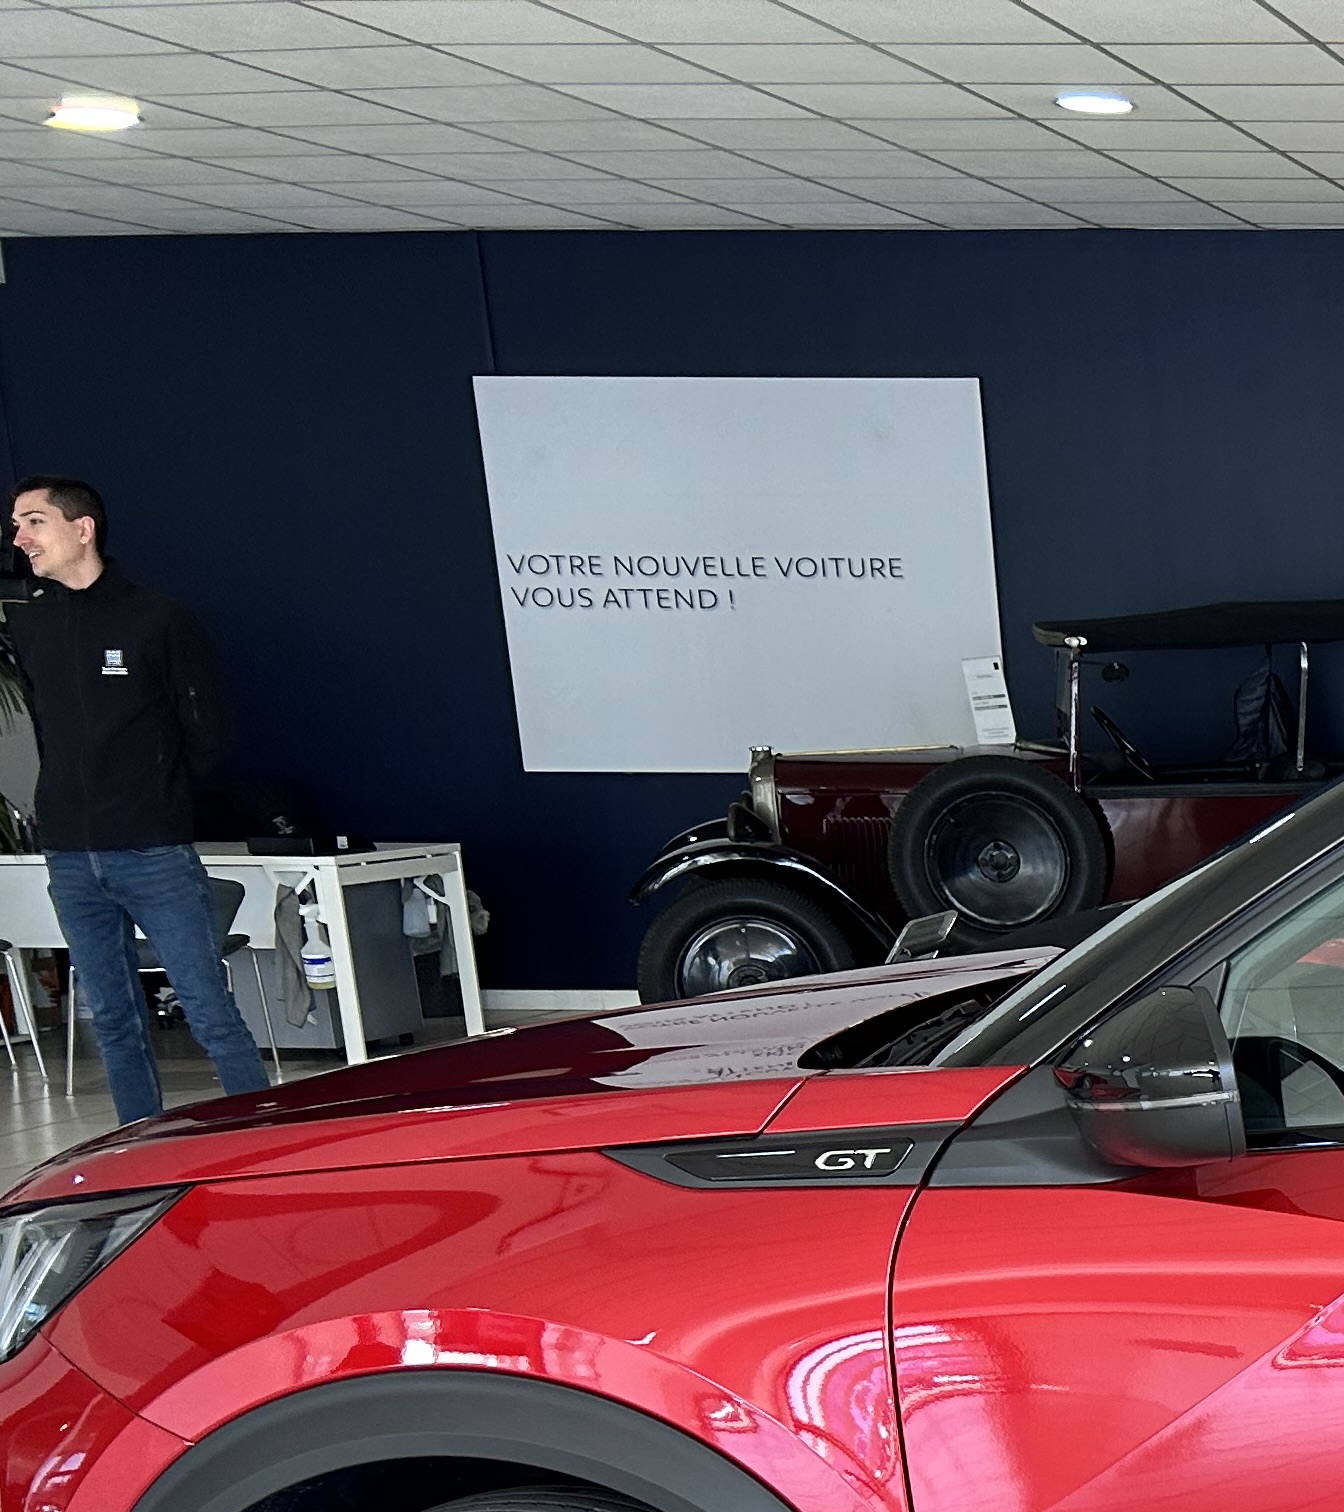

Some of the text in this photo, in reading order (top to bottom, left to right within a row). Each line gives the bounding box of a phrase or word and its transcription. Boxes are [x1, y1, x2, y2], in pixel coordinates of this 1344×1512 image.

[506, 553, 904, 579] VOTRE NOUVELLE VOITURE
[511, 586, 593, 608] VOUS
[603, 588, 718, 610] ATTEND
[814, 1148, 892, 1171] GT
